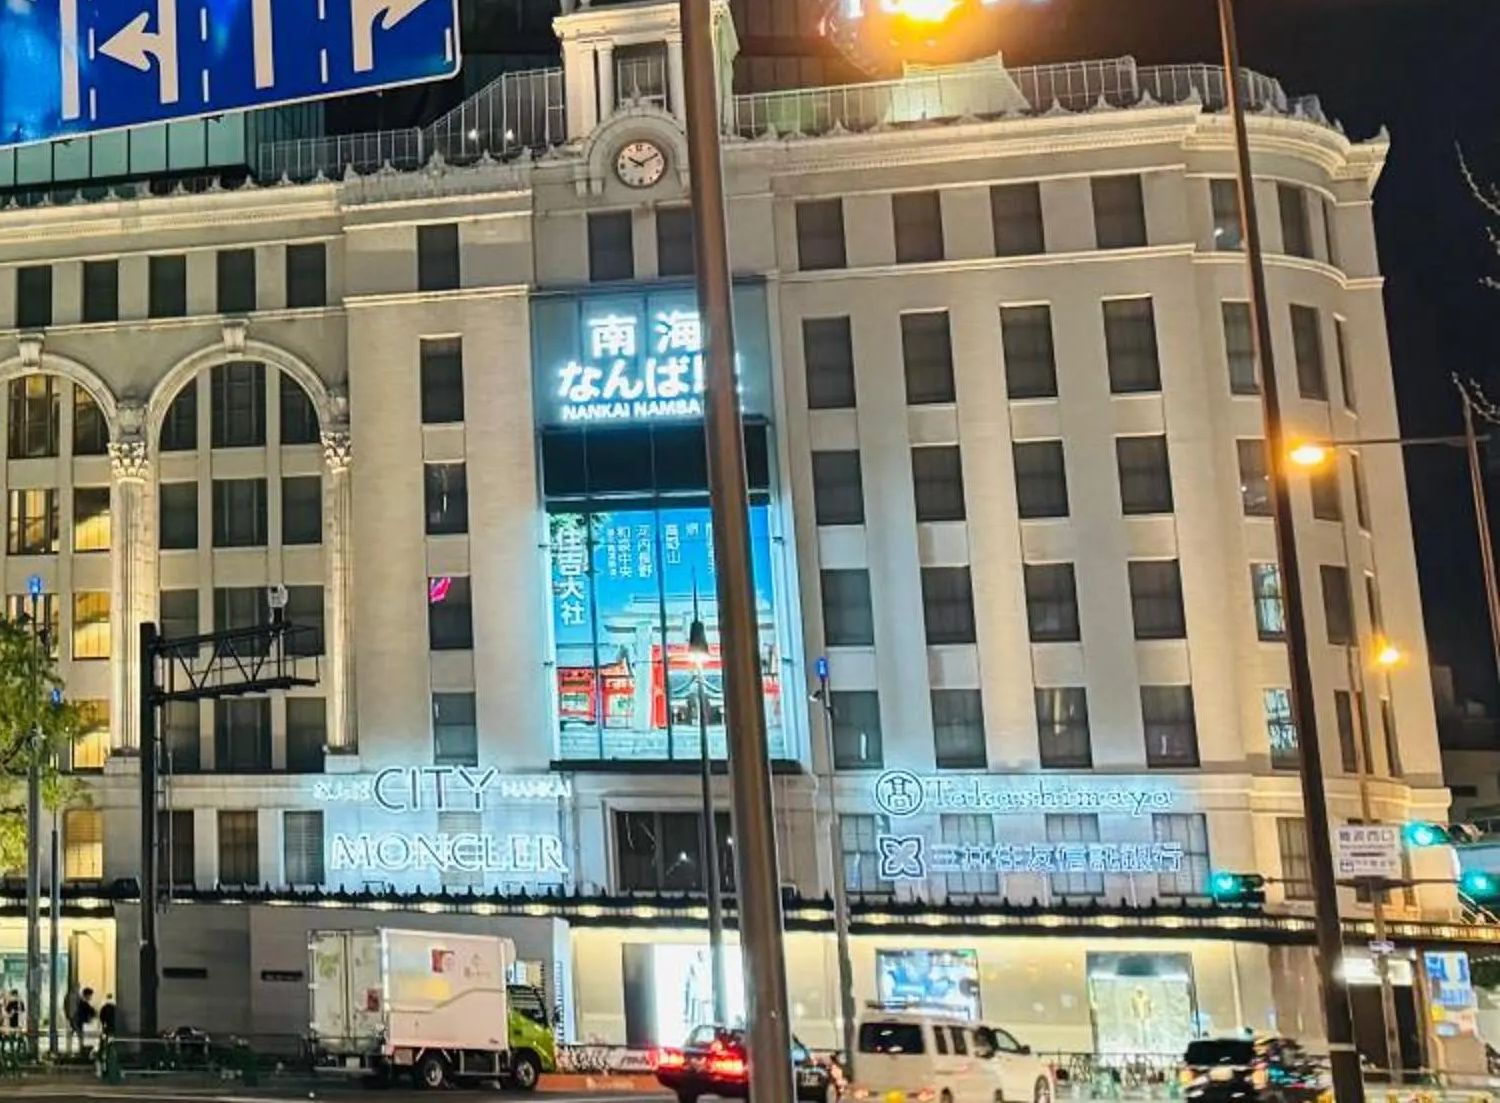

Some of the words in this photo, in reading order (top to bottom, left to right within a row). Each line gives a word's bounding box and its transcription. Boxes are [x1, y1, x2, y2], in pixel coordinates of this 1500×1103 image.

[589, 310, 703, 358] 南海
[562, 401, 631, 420] NANKAI
[634, 397, 700, 417] NAMBA
[556, 528, 588, 626] 住吉大社
[374, 767, 498, 811] CITY
[926, 777, 1173, 816] Takashimaya
[332, 832, 568, 872] MONCLER
